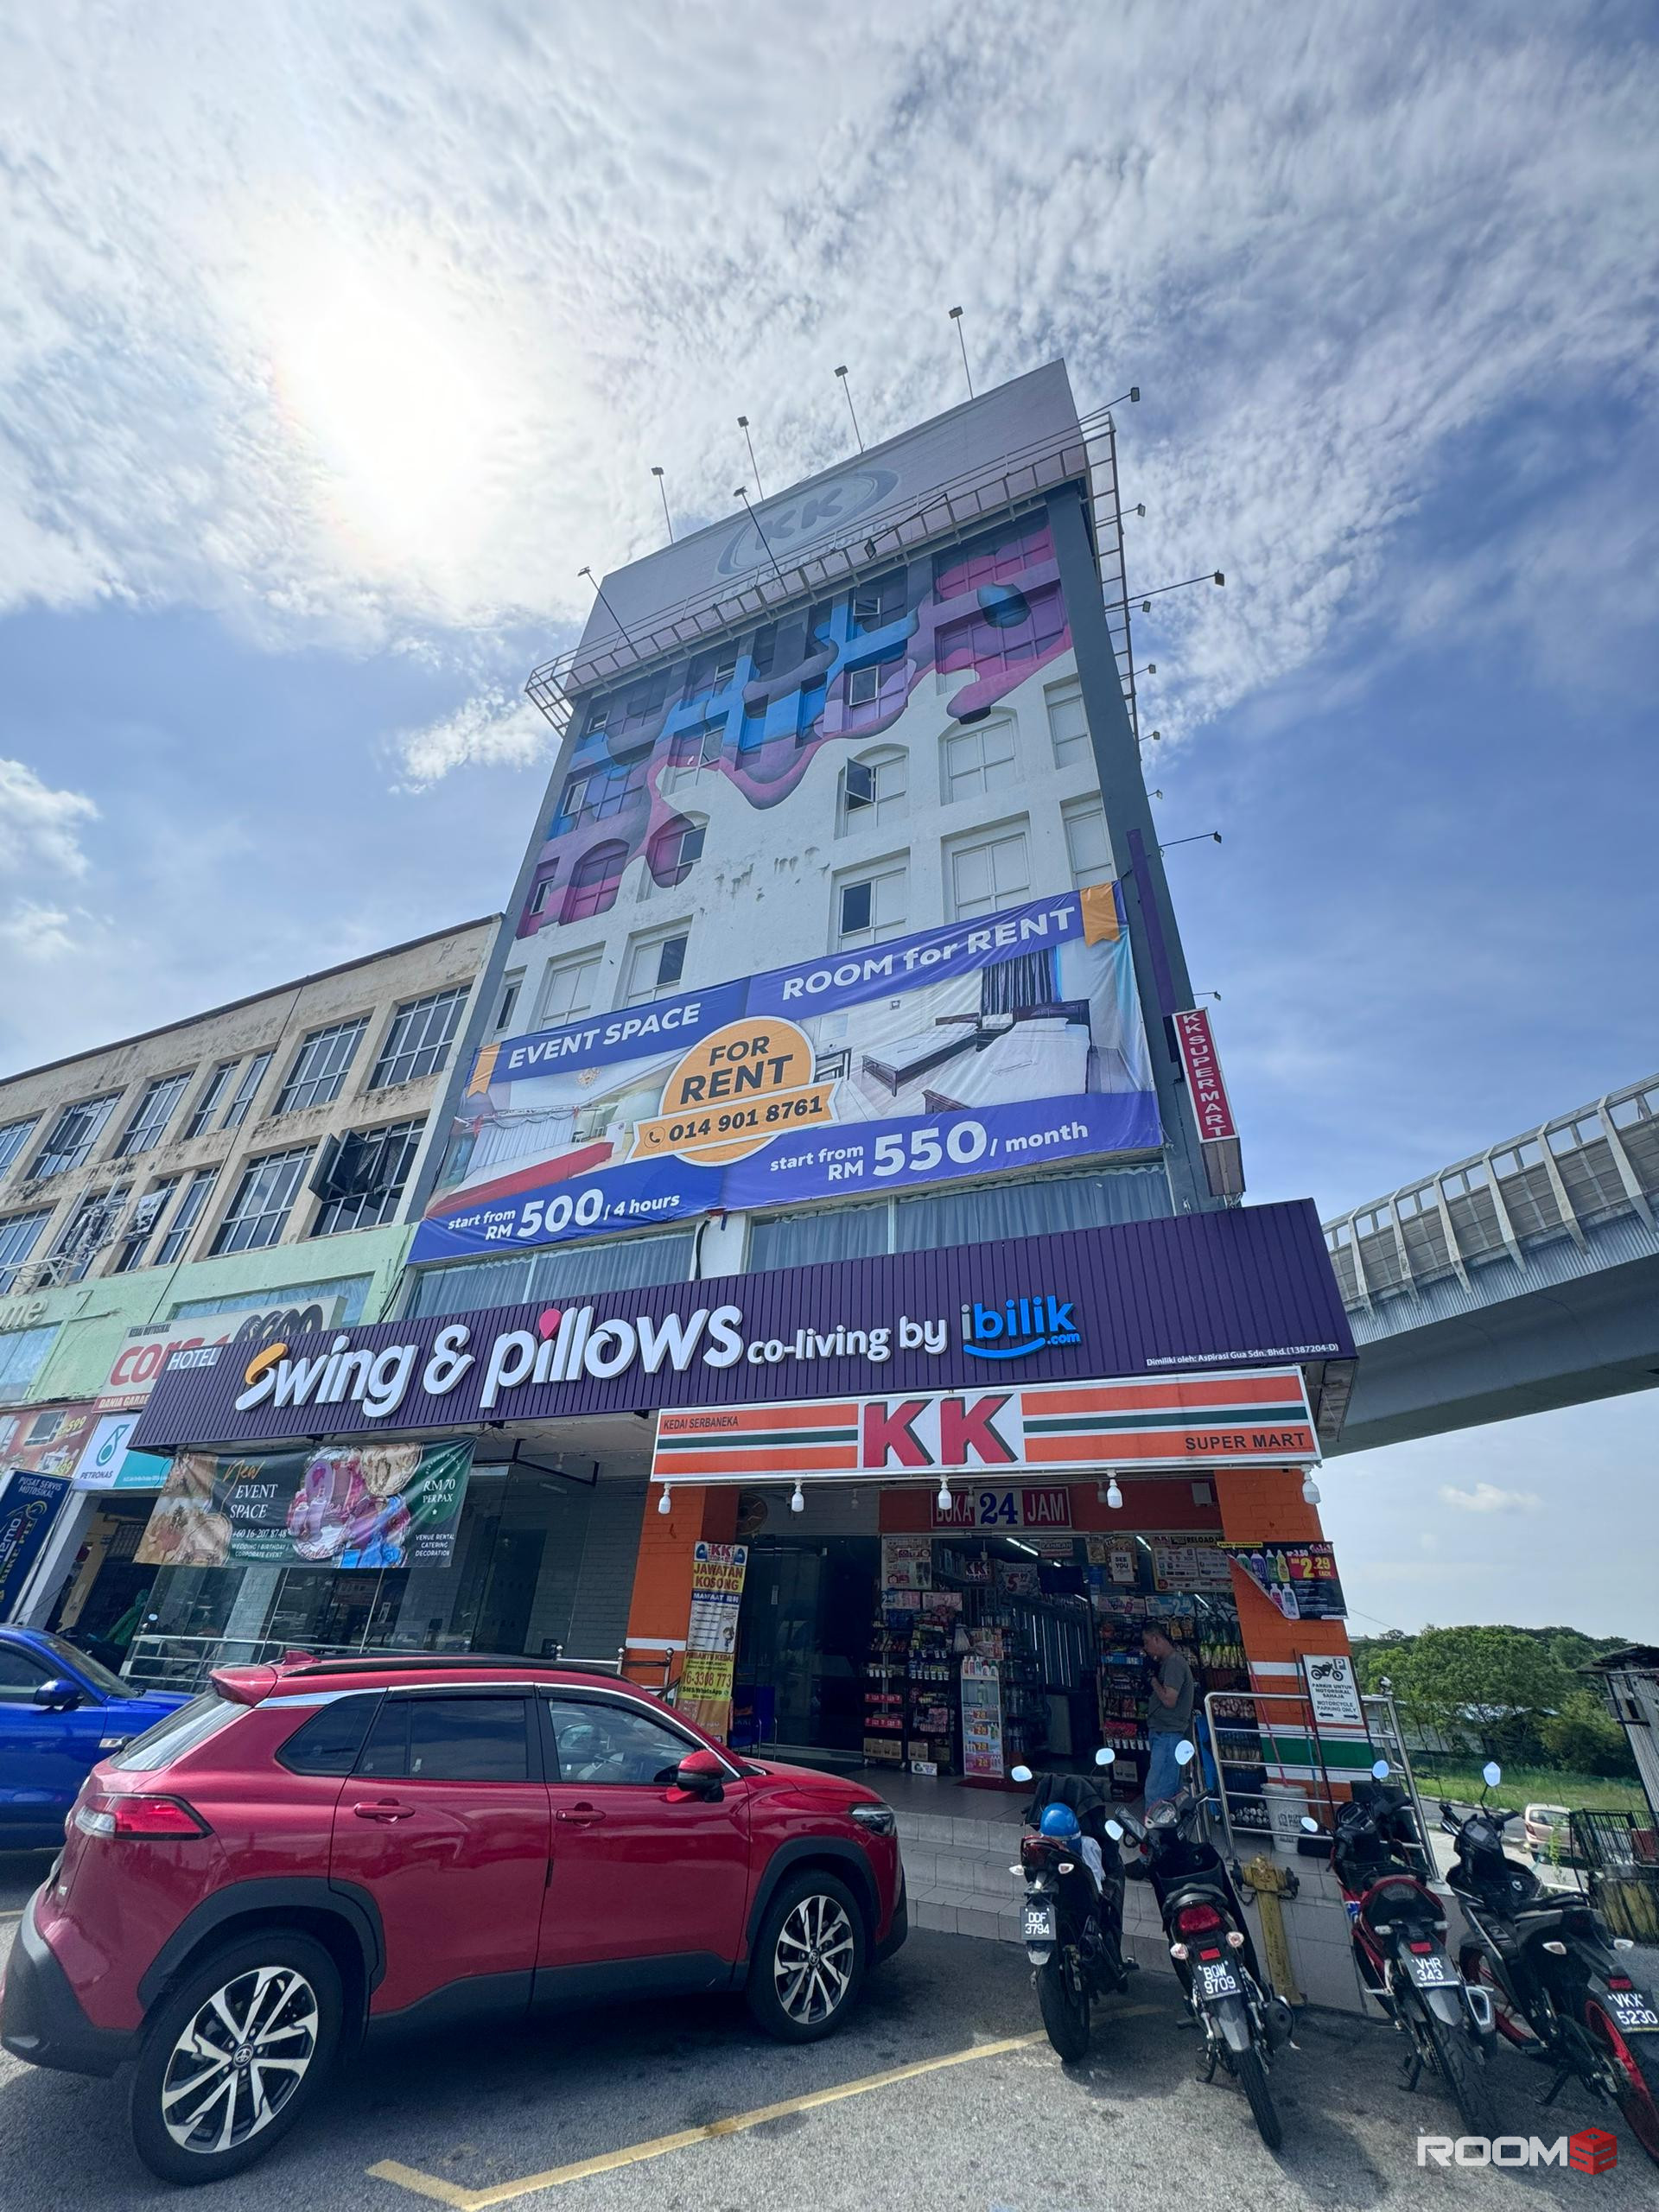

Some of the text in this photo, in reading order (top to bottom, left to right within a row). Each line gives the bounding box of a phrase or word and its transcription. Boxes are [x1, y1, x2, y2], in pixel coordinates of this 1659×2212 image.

[782, 906, 1076, 1001] ROOM for RENT
[508, 1002, 702, 1070] EVENT SPACE
[709, 1035, 771, 1067] FOR
[680, 1053, 793, 1105] RENT
[669, 1096, 823, 1142] 014 901 8761
[769, 1144, 864, 1173] start from
[828, 1122, 1089, 1181] RM 550 / month
[448, 1208, 516, 1230] start from
[485, 1188, 680, 1241] RM 500 / 4 hours
[1047, 1331, 1081, 1345] .com
[168, 1347, 218, 1371] HOTEL
[235, 1295, 1079, 1419] Swing & pillows co-living by ibilik
[1147, 1356, 1176, 1367] Dimiliki
[1178, 1354, 1197, 1364] oleh:
[1198, 1351, 1230, 1363] Aspirasi
[1230, 1351, 1247, 1360] Gua
[1249, 1349, 1267, 1359] Sdn.
[1268, 1347, 1287, 1357] Bhd.
[664, 1414, 740, 1430] KEDAI SERBANEKA
[863, 1393, 1020, 1469] KK
[1185, 1432, 1306, 1452] SUPER MART
[18, 1477, 63, 1491] PUSAT SERVIS
[79, 1470, 114, 1480] PETRONAS
[18, 1485, 54, 1498] MOTOSIKAL
[235, 1484, 278, 1499] EVENT
[230, 1504, 268, 1519] SPACE
[979, 1492, 1019, 1524] 24
[1027, 1493, 1065, 1522] JAM
[232, 1529, 245, 1538] +60
[270, 1529, 287, 1538] 8748
[710, 1544, 733, 1556] KK
[694, 1563, 743, 1579] JAWATAN
[695, 1575, 740, 1590] KOSONG
[1025, 1923, 1050, 1935] 3794
[1203, 1962, 1227, 1980] BQW
[1415, 1957, 1444, 1970] VHR
[1417, 1968, 1444, 1981] 343
[1204, 1975, 1236, 1994] 9709
[1611, 1993, 1644, 2008] VKX
[1616, 2010, 1658, 2024] 5230
